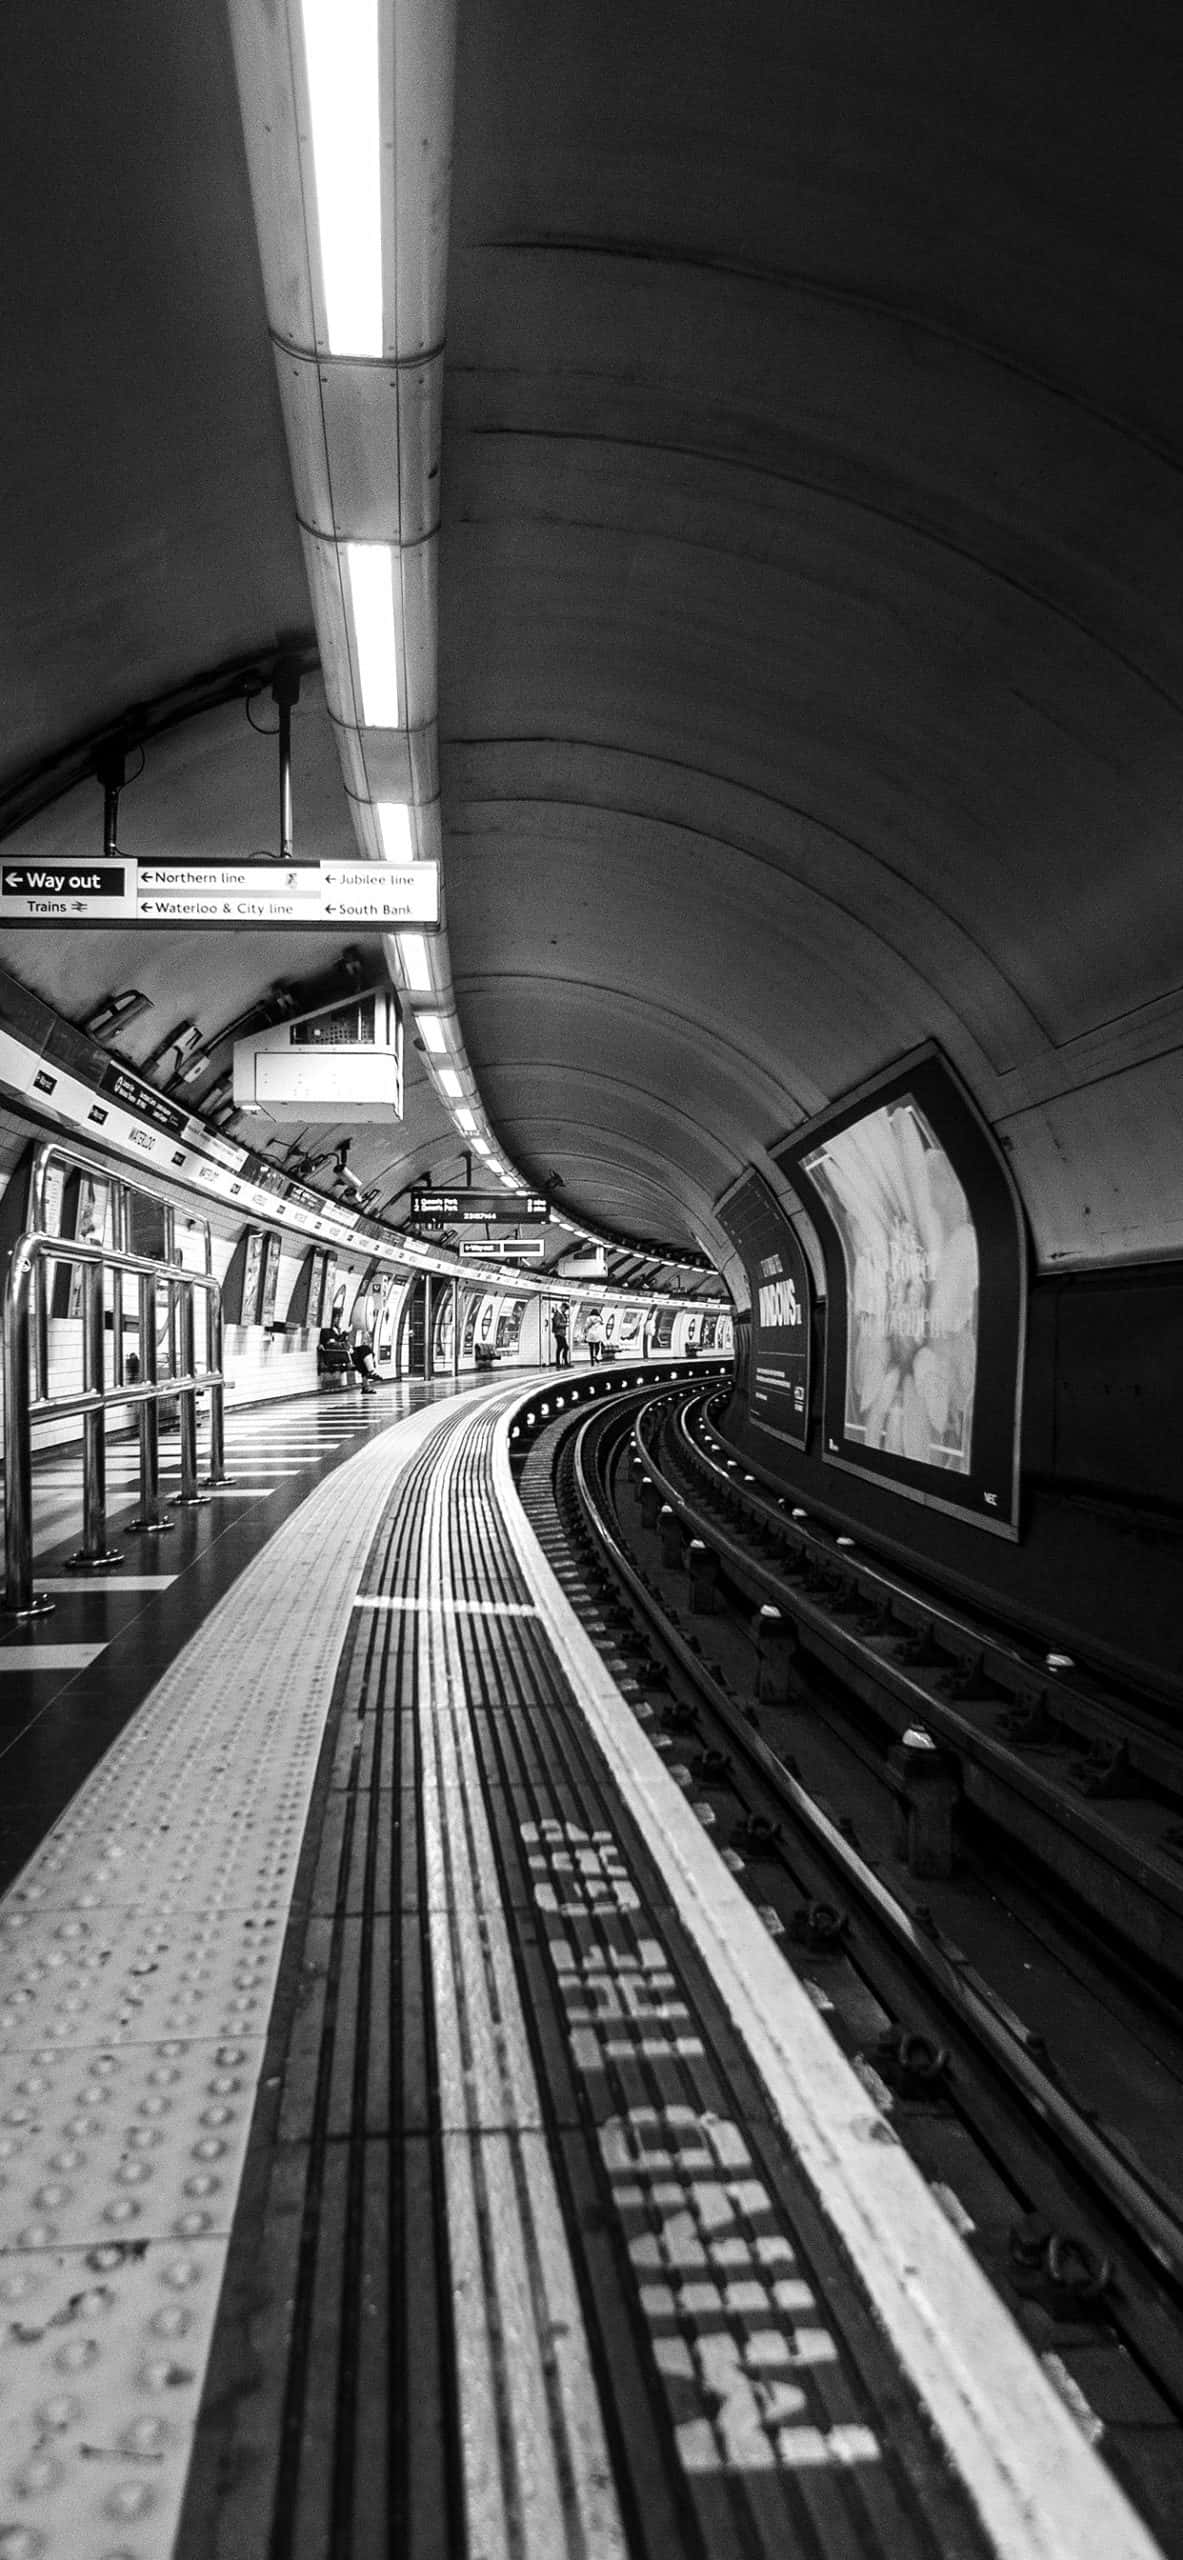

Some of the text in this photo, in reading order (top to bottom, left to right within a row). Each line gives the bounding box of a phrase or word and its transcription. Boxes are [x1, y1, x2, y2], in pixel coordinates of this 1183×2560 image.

[27, 871, 102, 891] Way out
[155, 871, 246, 884] Northern line
[339, 873, 415, 887] Jubilee line
[27, 900, 67, 913] Trains
[155, 902, 294, 916] Waterloo & City line
[339, 904, 413, 916] South Bank
[520, 1818, 881, 2472] MIND THE GAP
